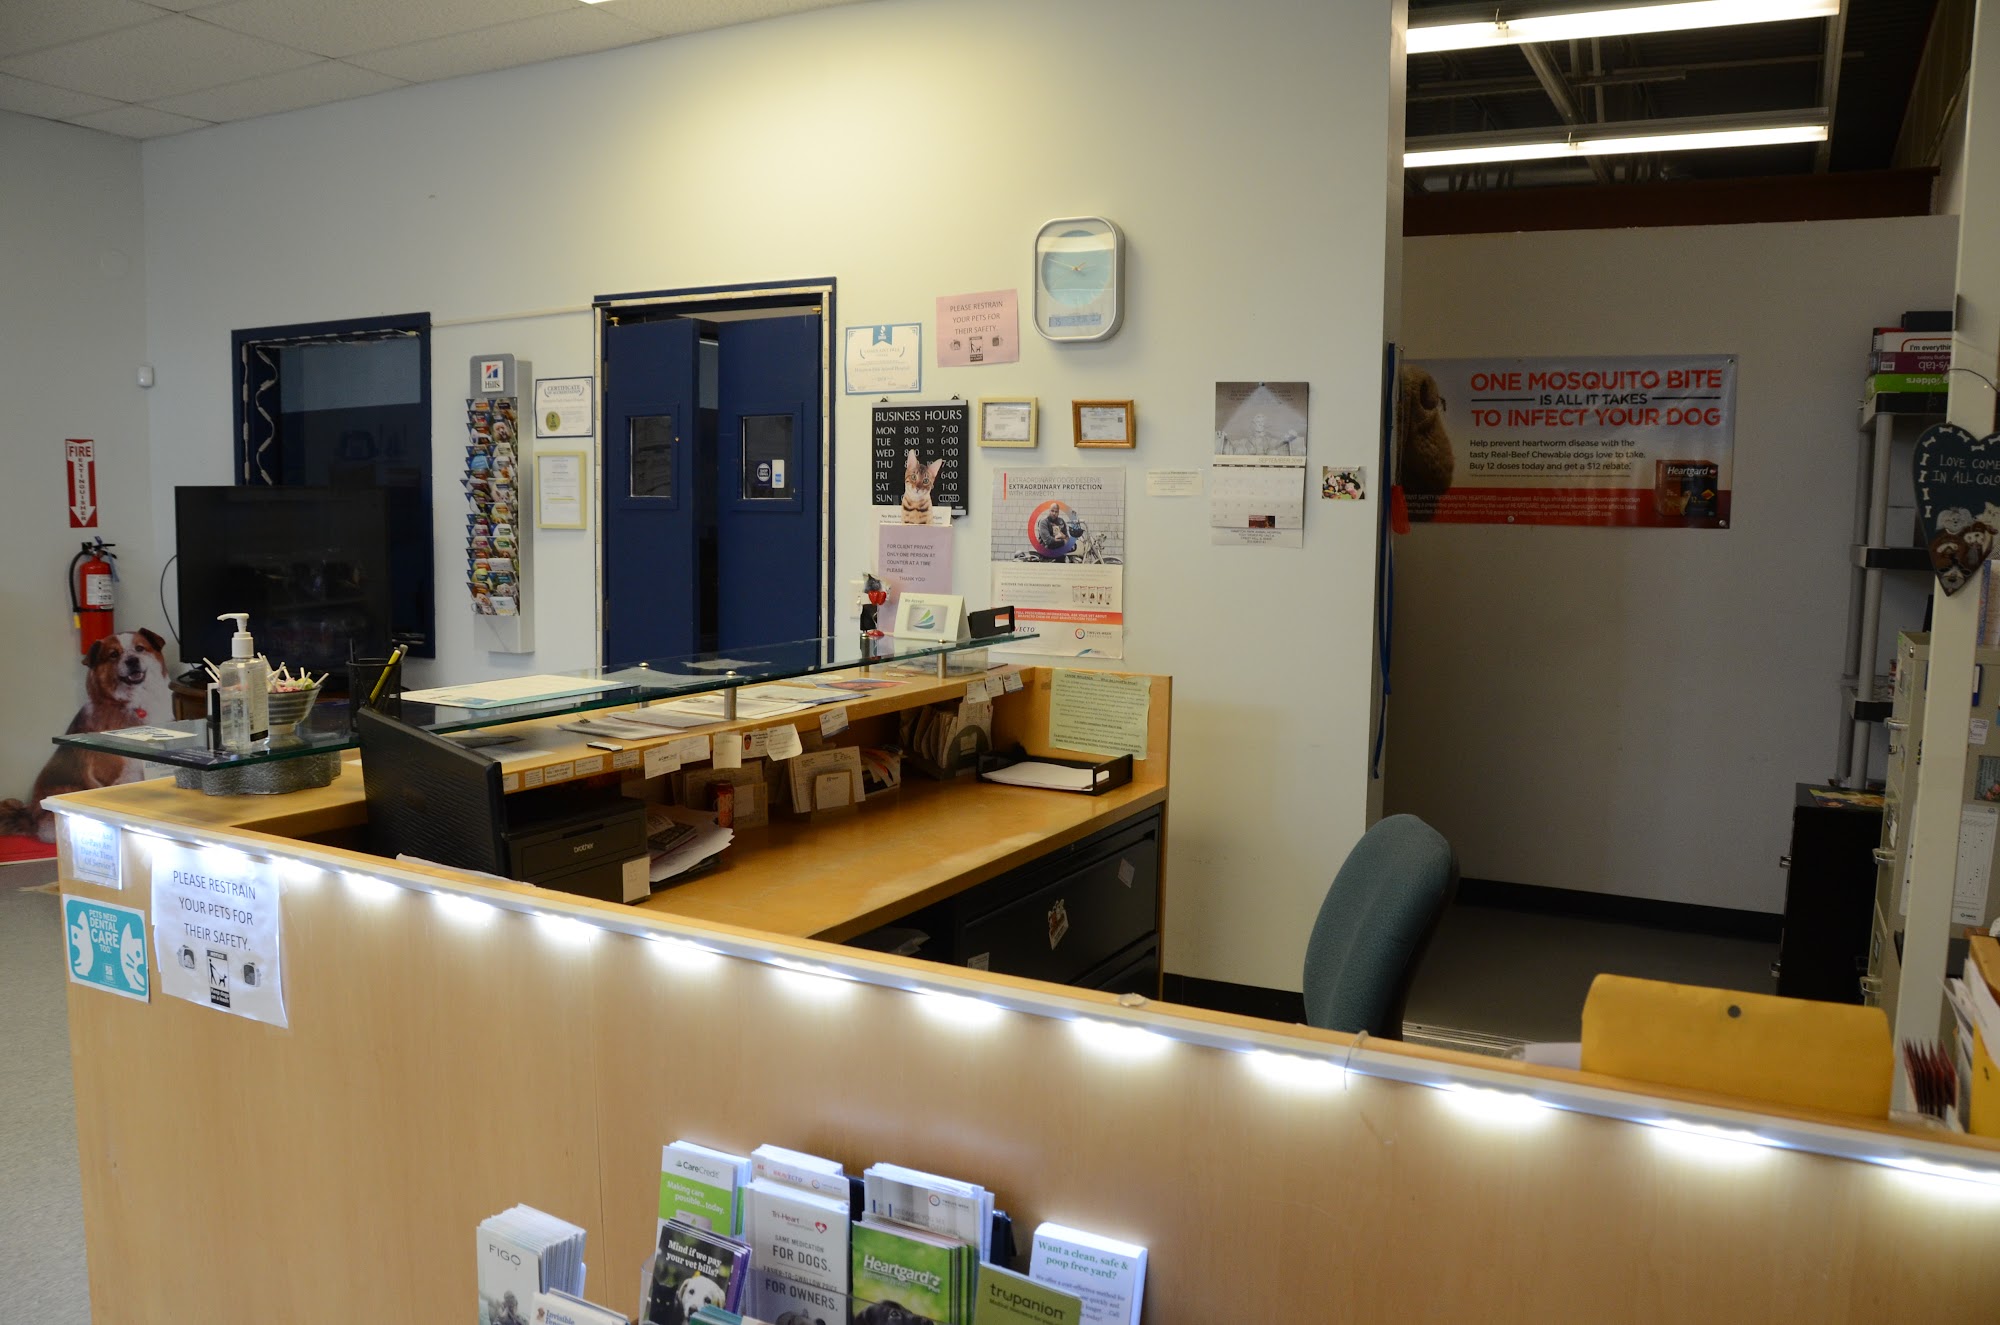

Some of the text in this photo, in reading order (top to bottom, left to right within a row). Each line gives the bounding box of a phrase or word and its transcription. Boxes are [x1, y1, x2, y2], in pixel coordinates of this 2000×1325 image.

[950, 301, 1003, 313] PLEASE RESTRAIN
[952, 315, 971, 324] YOUR
[988, 312, 1000, 320] FOR
[955, 327, 973, 335] THEIR
[1470, 369, 1722, 392] ONE MOSQUITO BITE
[1540, 393, 1648, 406] IS ALL IT TAKES
[875, 409, 962, 422] BUSINESS HOURS
[1471, 407, 1721, 427] TO INFECT YOUR DOG
[875, 426, 896, 435] MON
[903, 425, 919, 435] 8:00
[941, 425, 959, 434] 7:00
[875, 437, 891, 447] TUE
[903, 437, 920, 446] 8:00
[940, 436, 959, 445] 6:00
[1470, 440, 1488, 448] Help
[69, 446, 92, 458] FIRE
[875, 449, 895, 458] WED
[942, 448, 959, 457] 1:00
[942, 460, 958, 468] 7:00
[1939, 453, 2000, 470] LOVE COME
[876, 471, 958, 480] FRI 6:00
[1667, 466, 1709, 478] Heartgard
[1931, 469, 2000, 486] IN ALL COLO
[77, 457, 86, 521] EXTINGUISHER
[876, 482, 958, 491] SAT 1:00
[875, 494, 893, 503] SUN
[573, 842, 594, 853] brother
[100, 851, 114, 861] Time
[92, 859, 111, 870] Service
[173, 870, 256, 900] PLEASE RESTRAIN
[88, 909, 118, 923] PETS NEED
[178, 896, 254, 926] YOUR PETS FOR
[90, 917, 119, 933] DENTAL
[91, 928, 120, 948] CARE
[184, 922, 251, 951] THEIR SAFETY.
[683, 1161, 719, 1179] CareCredit
[773, 1169, 803, 1183] BRAVECTO
[667, 1180, 705, 1198] Making care
[674, 1192, 725, 1215] possible... today.
[771, 1210, 800, 1224] Tri-Heart
[775, 1234, 825, 1253] SAME MEDICATION
[488, 1244, 522, 1267] FIGO
[668, 1240, 722, 1268] Mind if we pay
[772, 1245, 832, 1273] FOR DOGS.
[1038, 1240, 1062, 1254] Want
[1070, 1249, 1098, 1264] clean,
[1100, 1256, 1119, 1269] safe
[1120, 1261, 1129, 1271] &
[665, 1252, 719, 1278] your vet bills?
[863, 1254, 930, 1285] Heartgard
[1046, 1256, 1117, 1280] poop free yard?
[763, 1265, 838, 1292] EASIER-TO-SWALLOW PRICE
[765, 1279, 838, 1312] FOR OWNERS.
[1061, 1282, 1095, 1294] cost-effective
[1096, 1289, 1117, 1299] method
[989, 1283, 1064, 1321] trupanion
[1089, 1298, 1108, 1308] quickly
[546, 1309, 575, 1325] Invisible
